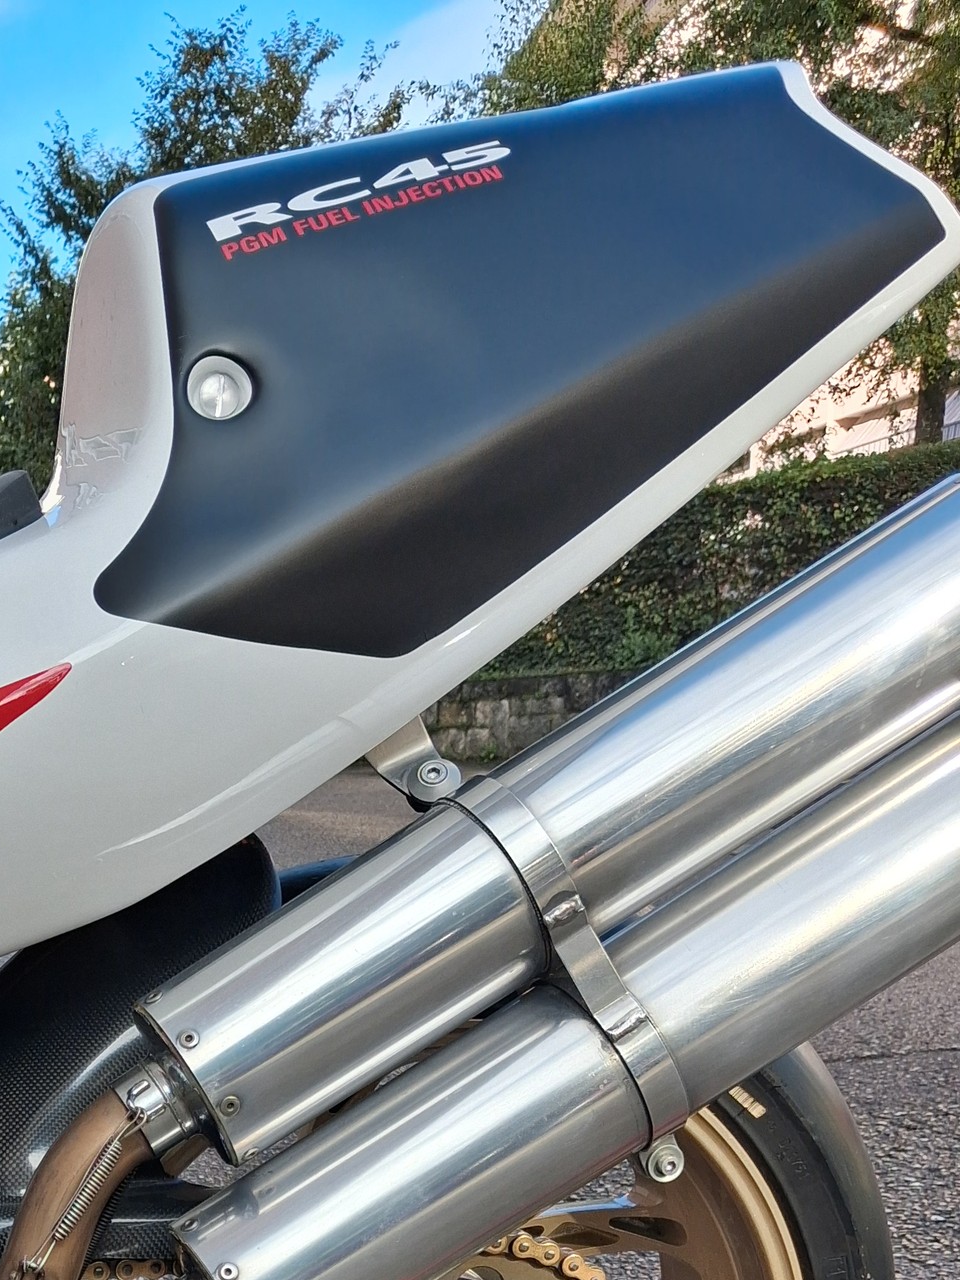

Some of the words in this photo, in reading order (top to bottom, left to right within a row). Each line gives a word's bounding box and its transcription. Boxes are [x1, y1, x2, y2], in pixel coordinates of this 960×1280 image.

[206, 140, 511, 241] RC45
[221, 226, 288, 261] PGM
[292, 206, 360, 236] FUEL
[361, 165, 503, 215] INJECTION
